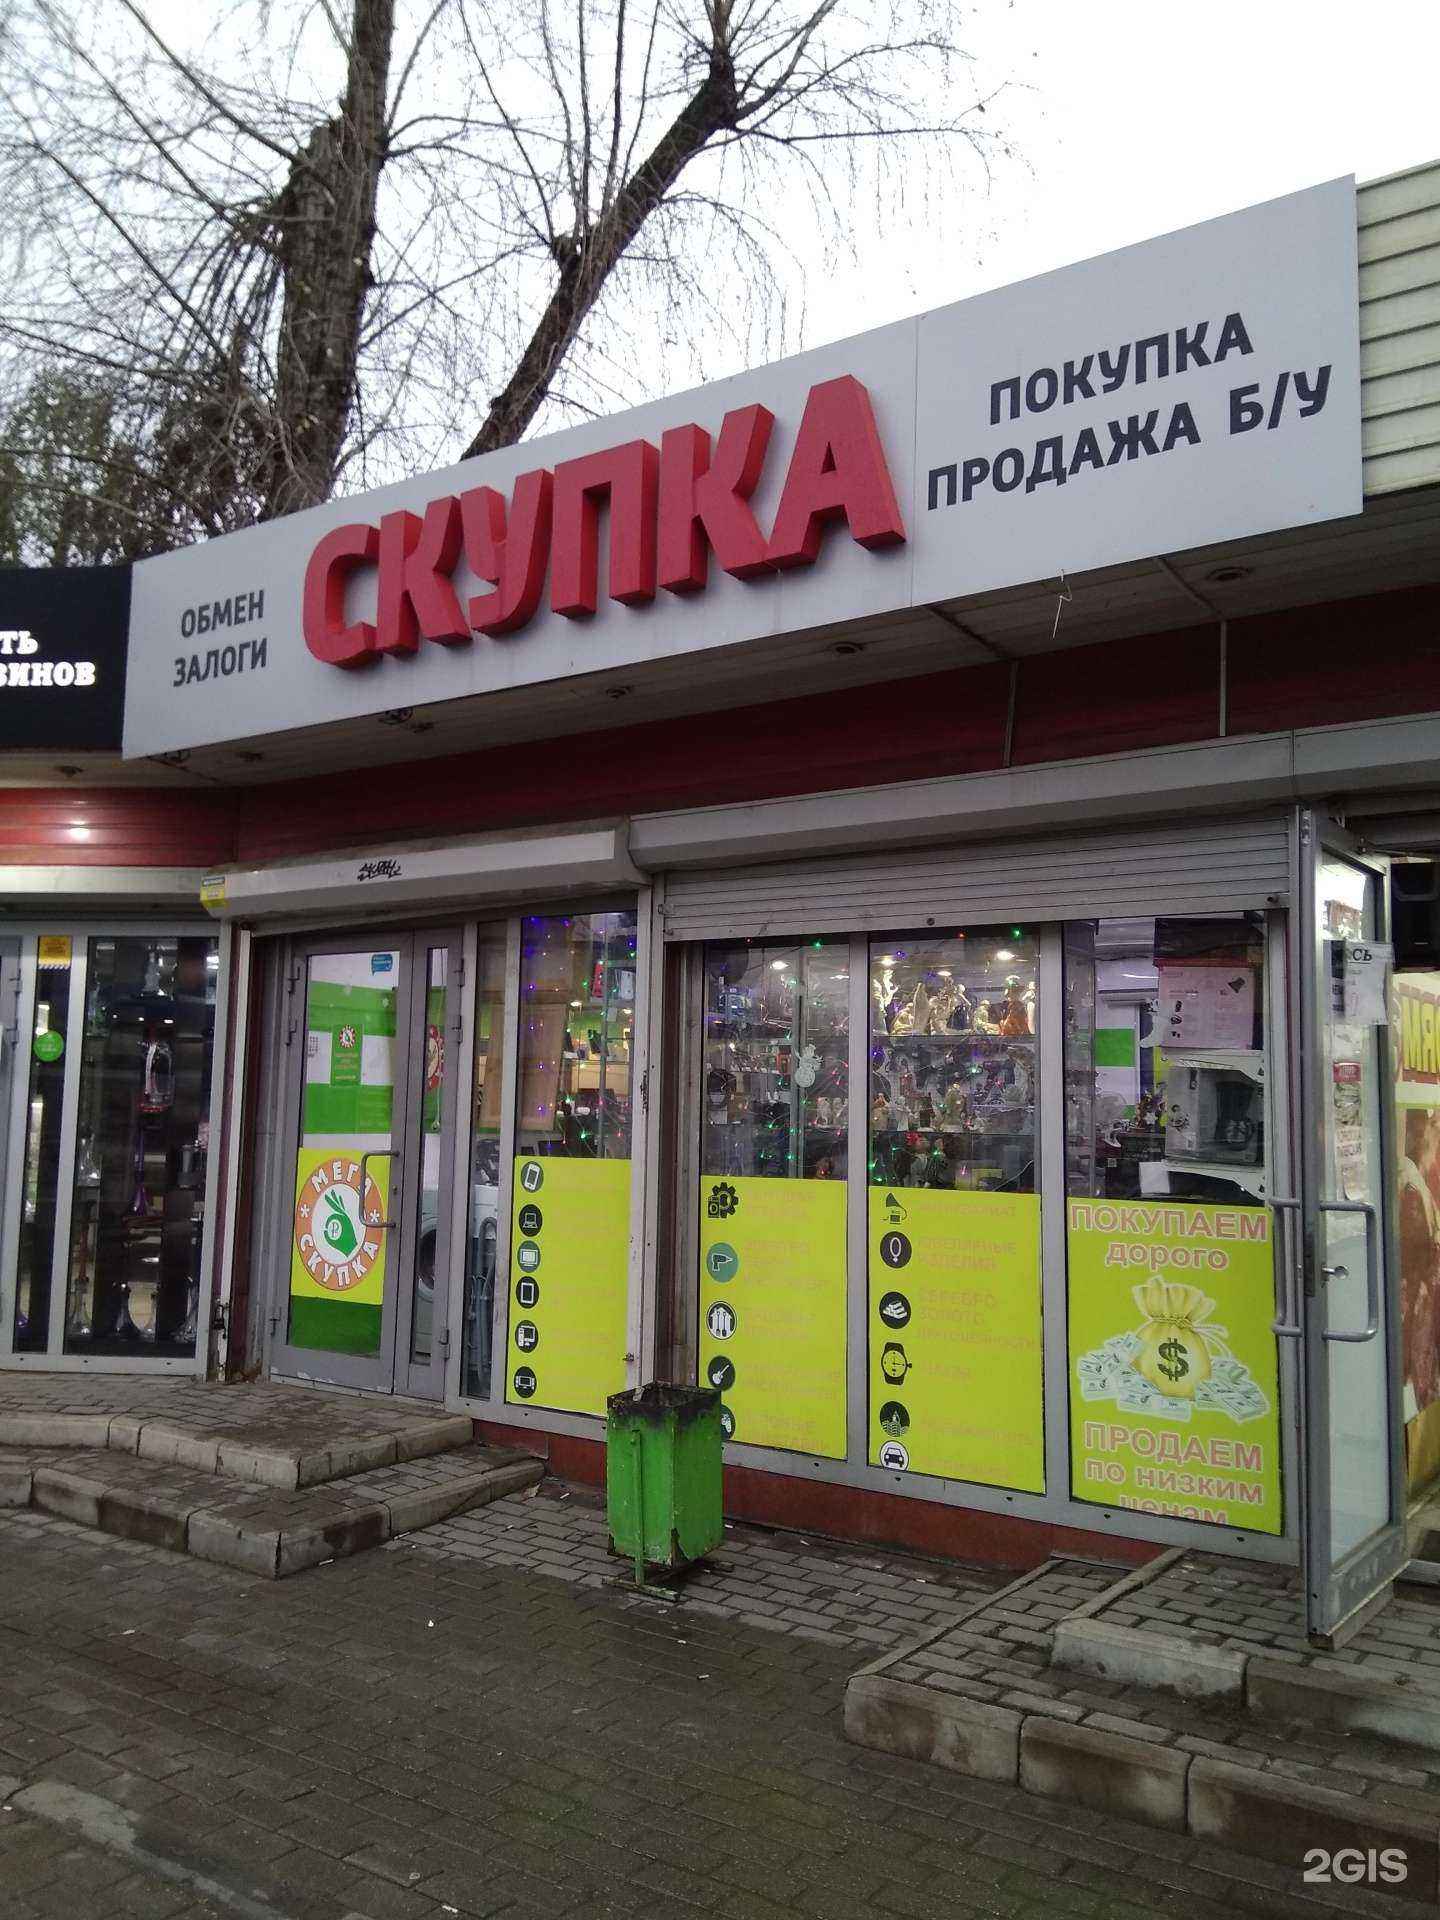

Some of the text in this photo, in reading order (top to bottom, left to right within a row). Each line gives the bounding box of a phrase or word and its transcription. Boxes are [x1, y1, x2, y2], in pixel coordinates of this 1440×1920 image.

[989, 312, 1254, 426] ПОКУПКА
[927, 364, 1332, 512] ПРОДАЖА Б/У
[302, 373, 906, 670] СКУПКА
[181, 589, 264, 638] ОБМЕН
[173, 638, 267, 687] ЗАЛОГИ
[1070, 1203, 1269, 1242] ПОКУПАЕМ
[299, 1233, 380, 1287] СКУПКА
[1105, 1242, 1229, 1271] дорого
[1084, 1421, 1264, 1473] ПРОДАЕМ
